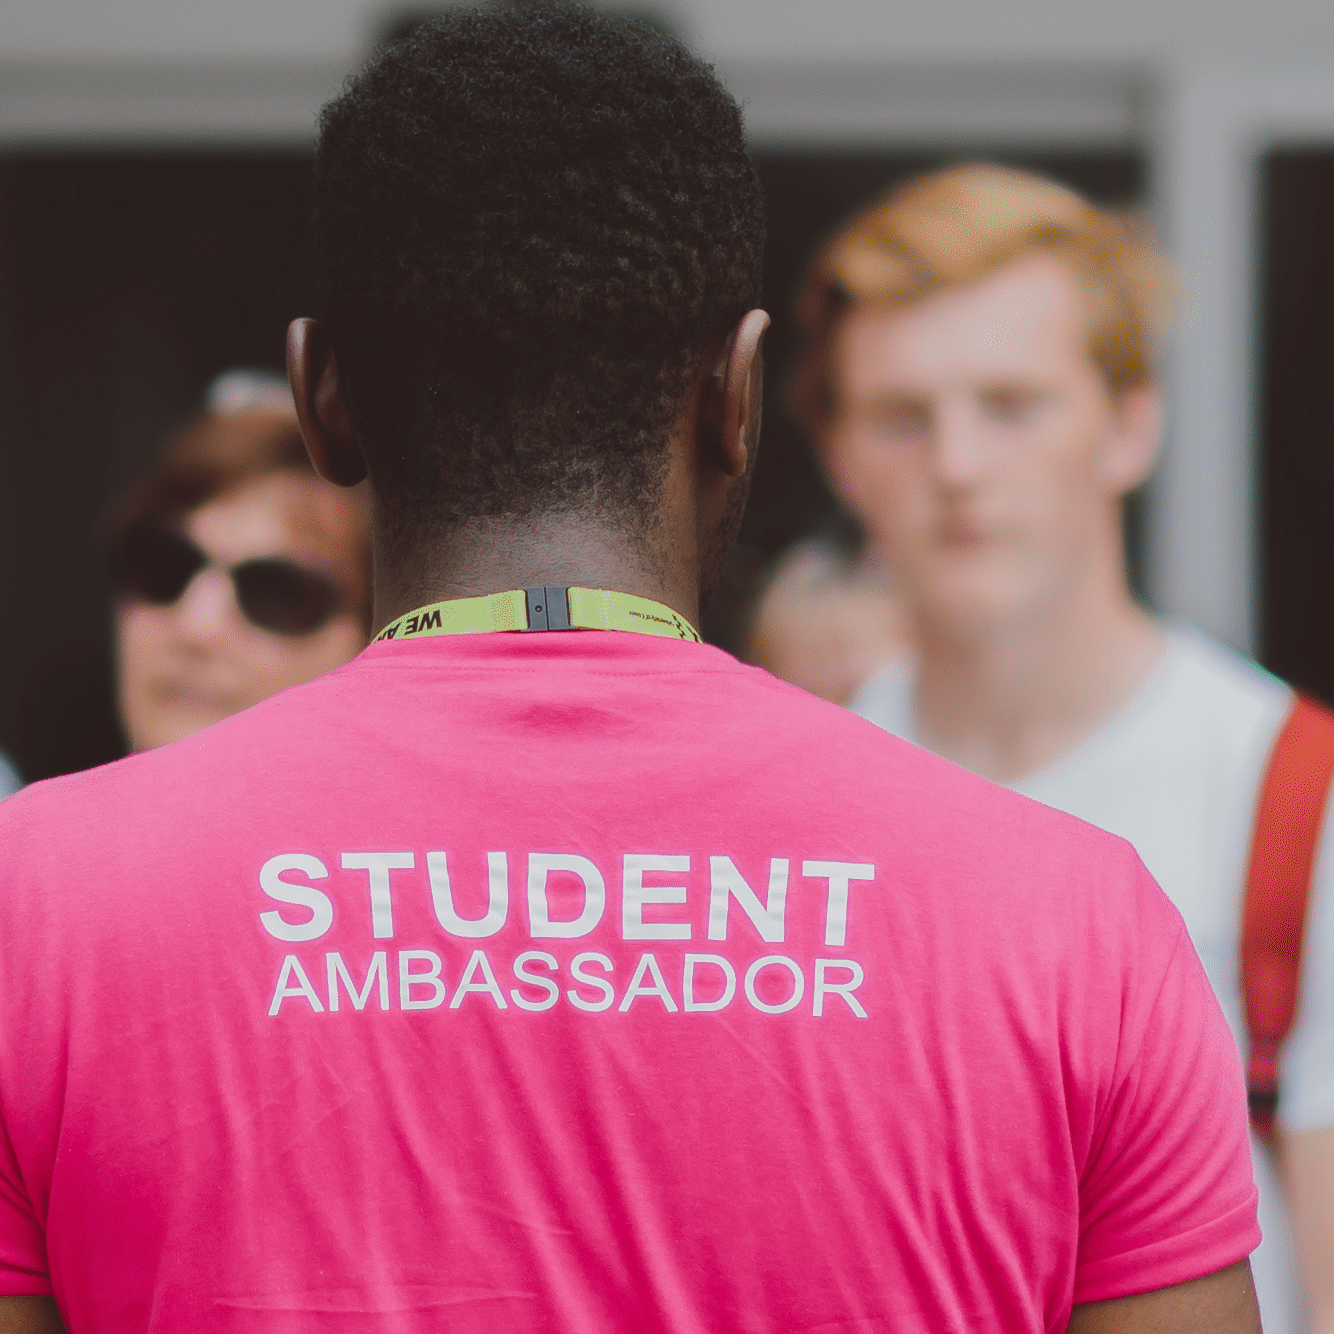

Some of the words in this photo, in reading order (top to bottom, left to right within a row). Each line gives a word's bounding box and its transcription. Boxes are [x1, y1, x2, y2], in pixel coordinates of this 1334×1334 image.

[404, 609, 443, 636] WE
[258, 851, 875, 947] STUDENT
[268, 949, 868, 1019] AMBASSADOR
